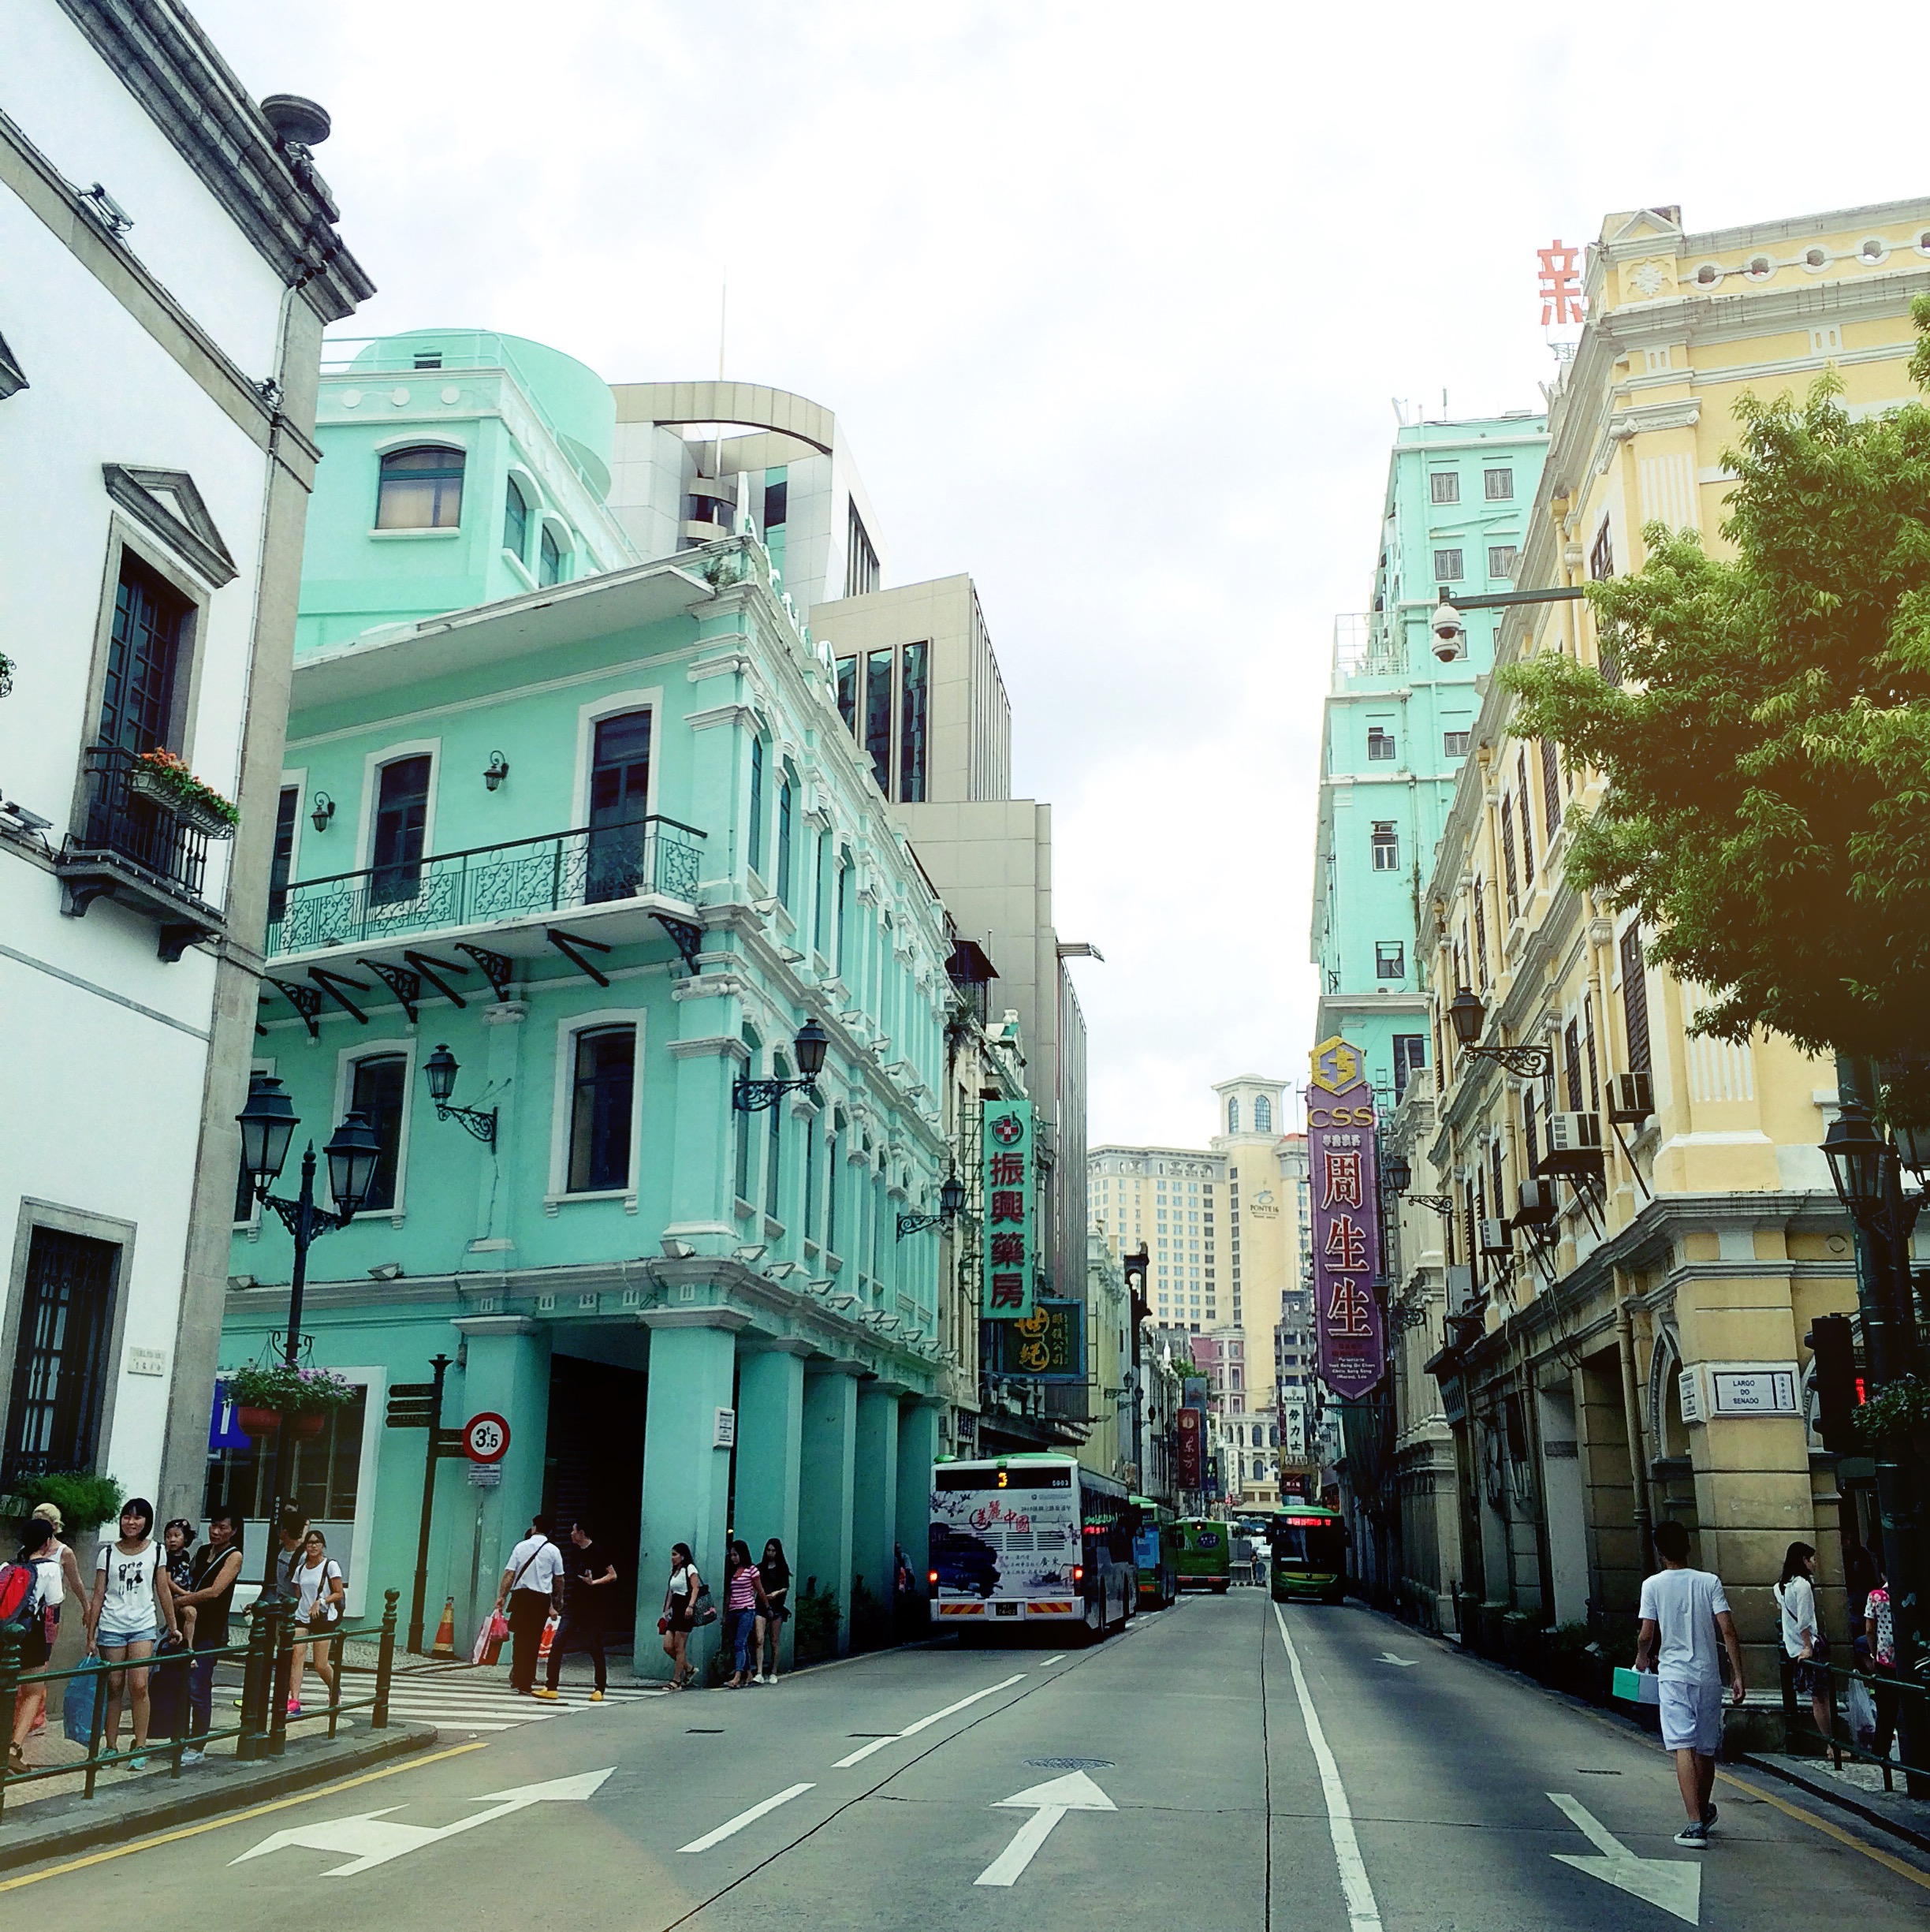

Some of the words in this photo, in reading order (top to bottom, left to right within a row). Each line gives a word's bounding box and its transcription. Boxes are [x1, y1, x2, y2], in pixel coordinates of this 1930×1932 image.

[1308, 1107, 1373, 1128] CSS
[989, 1151, 1025, 1309] 振興藥房
[1321, 1150, 1373, 1337] 周生生
[1288, 1408, 1302, 1451] 勞力士
[998, 1472, 1008, 1487] 3
